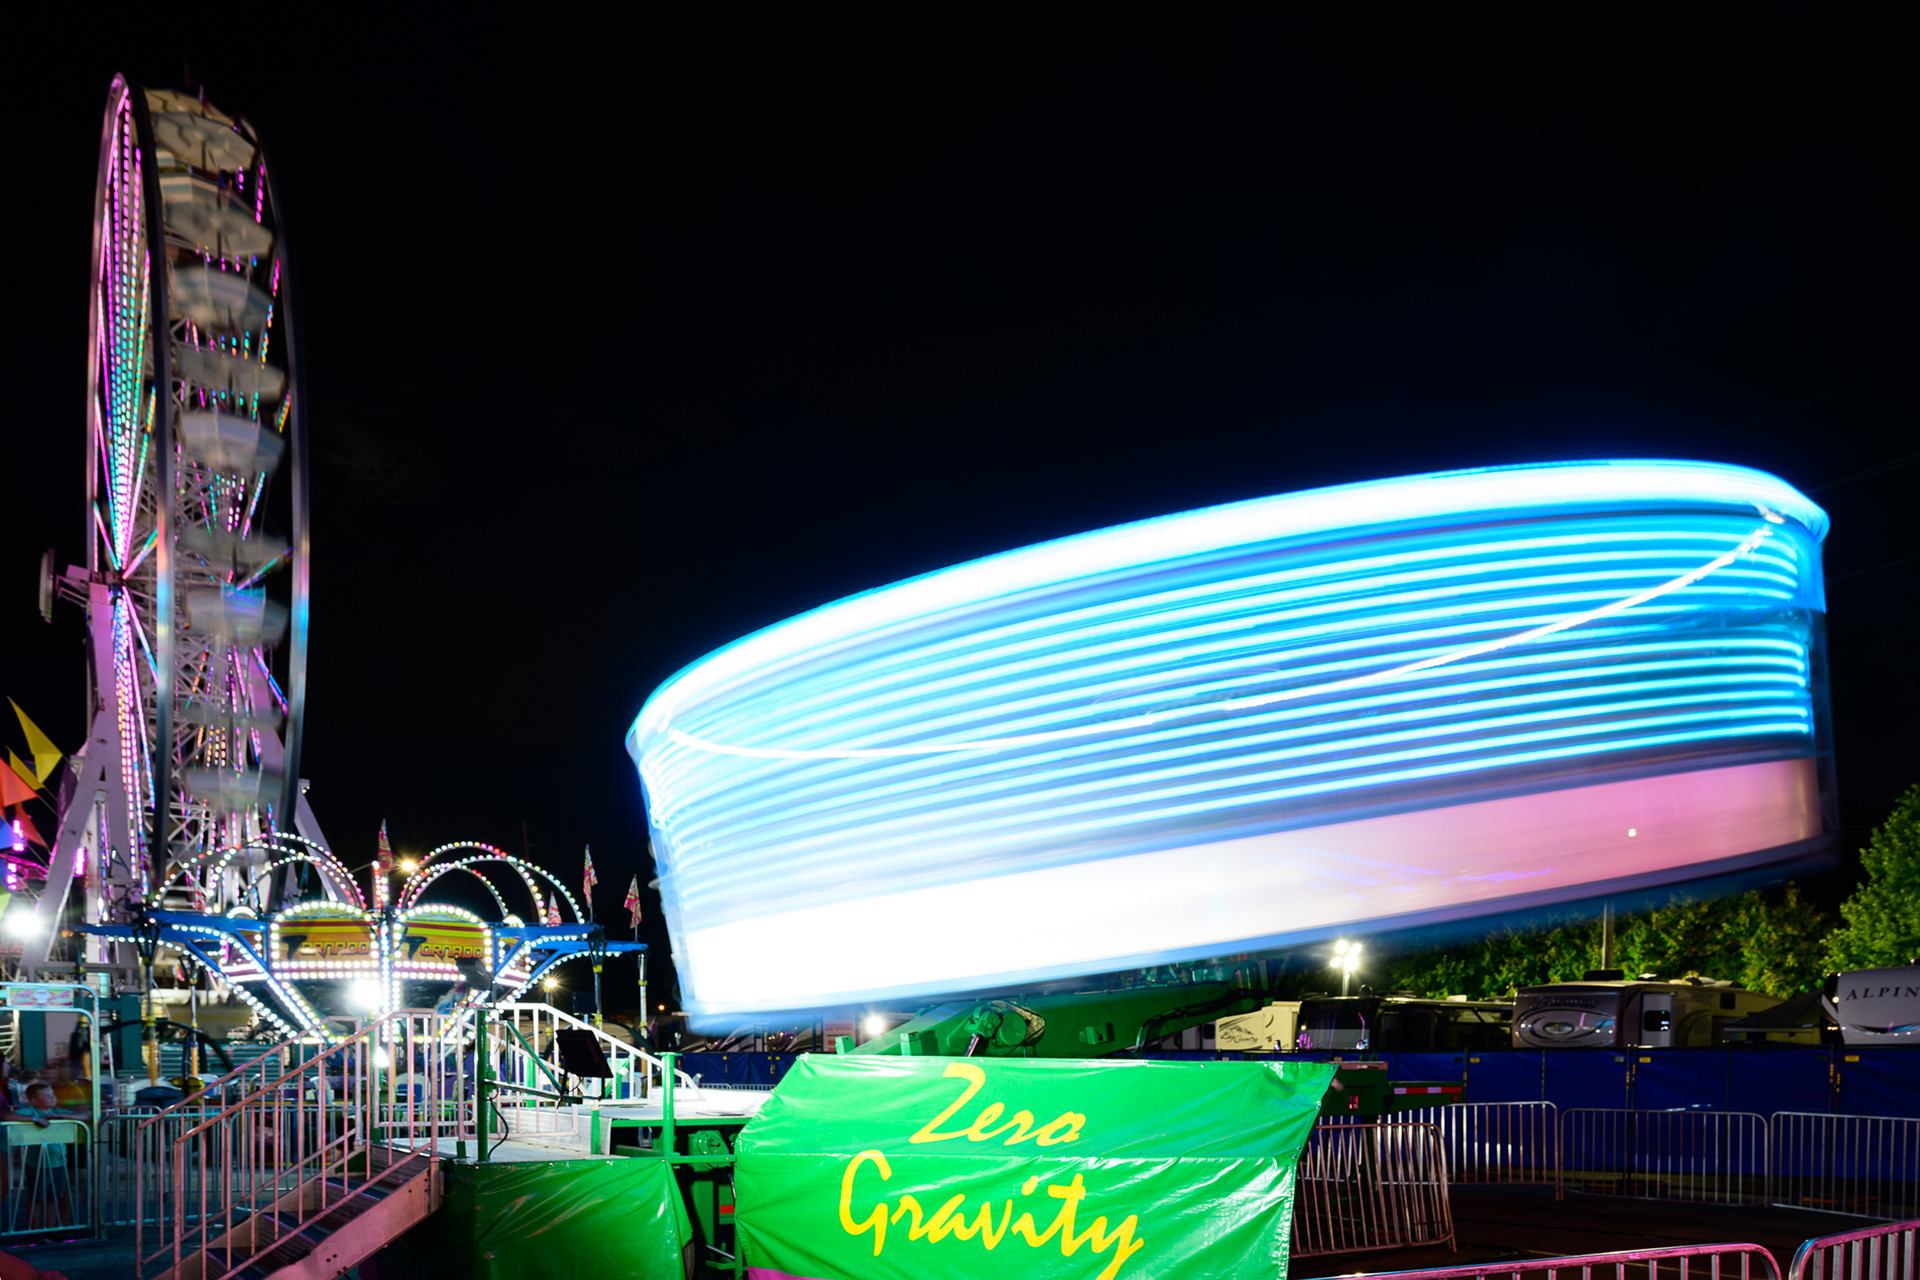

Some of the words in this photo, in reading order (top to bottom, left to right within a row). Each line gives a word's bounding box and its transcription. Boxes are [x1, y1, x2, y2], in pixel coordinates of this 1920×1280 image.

[1845, 986, 1920, 1001] ALPIN
[908, 1063, 1086, 1146] Zero
[839, 1149, 1144, 1280] Gravity
